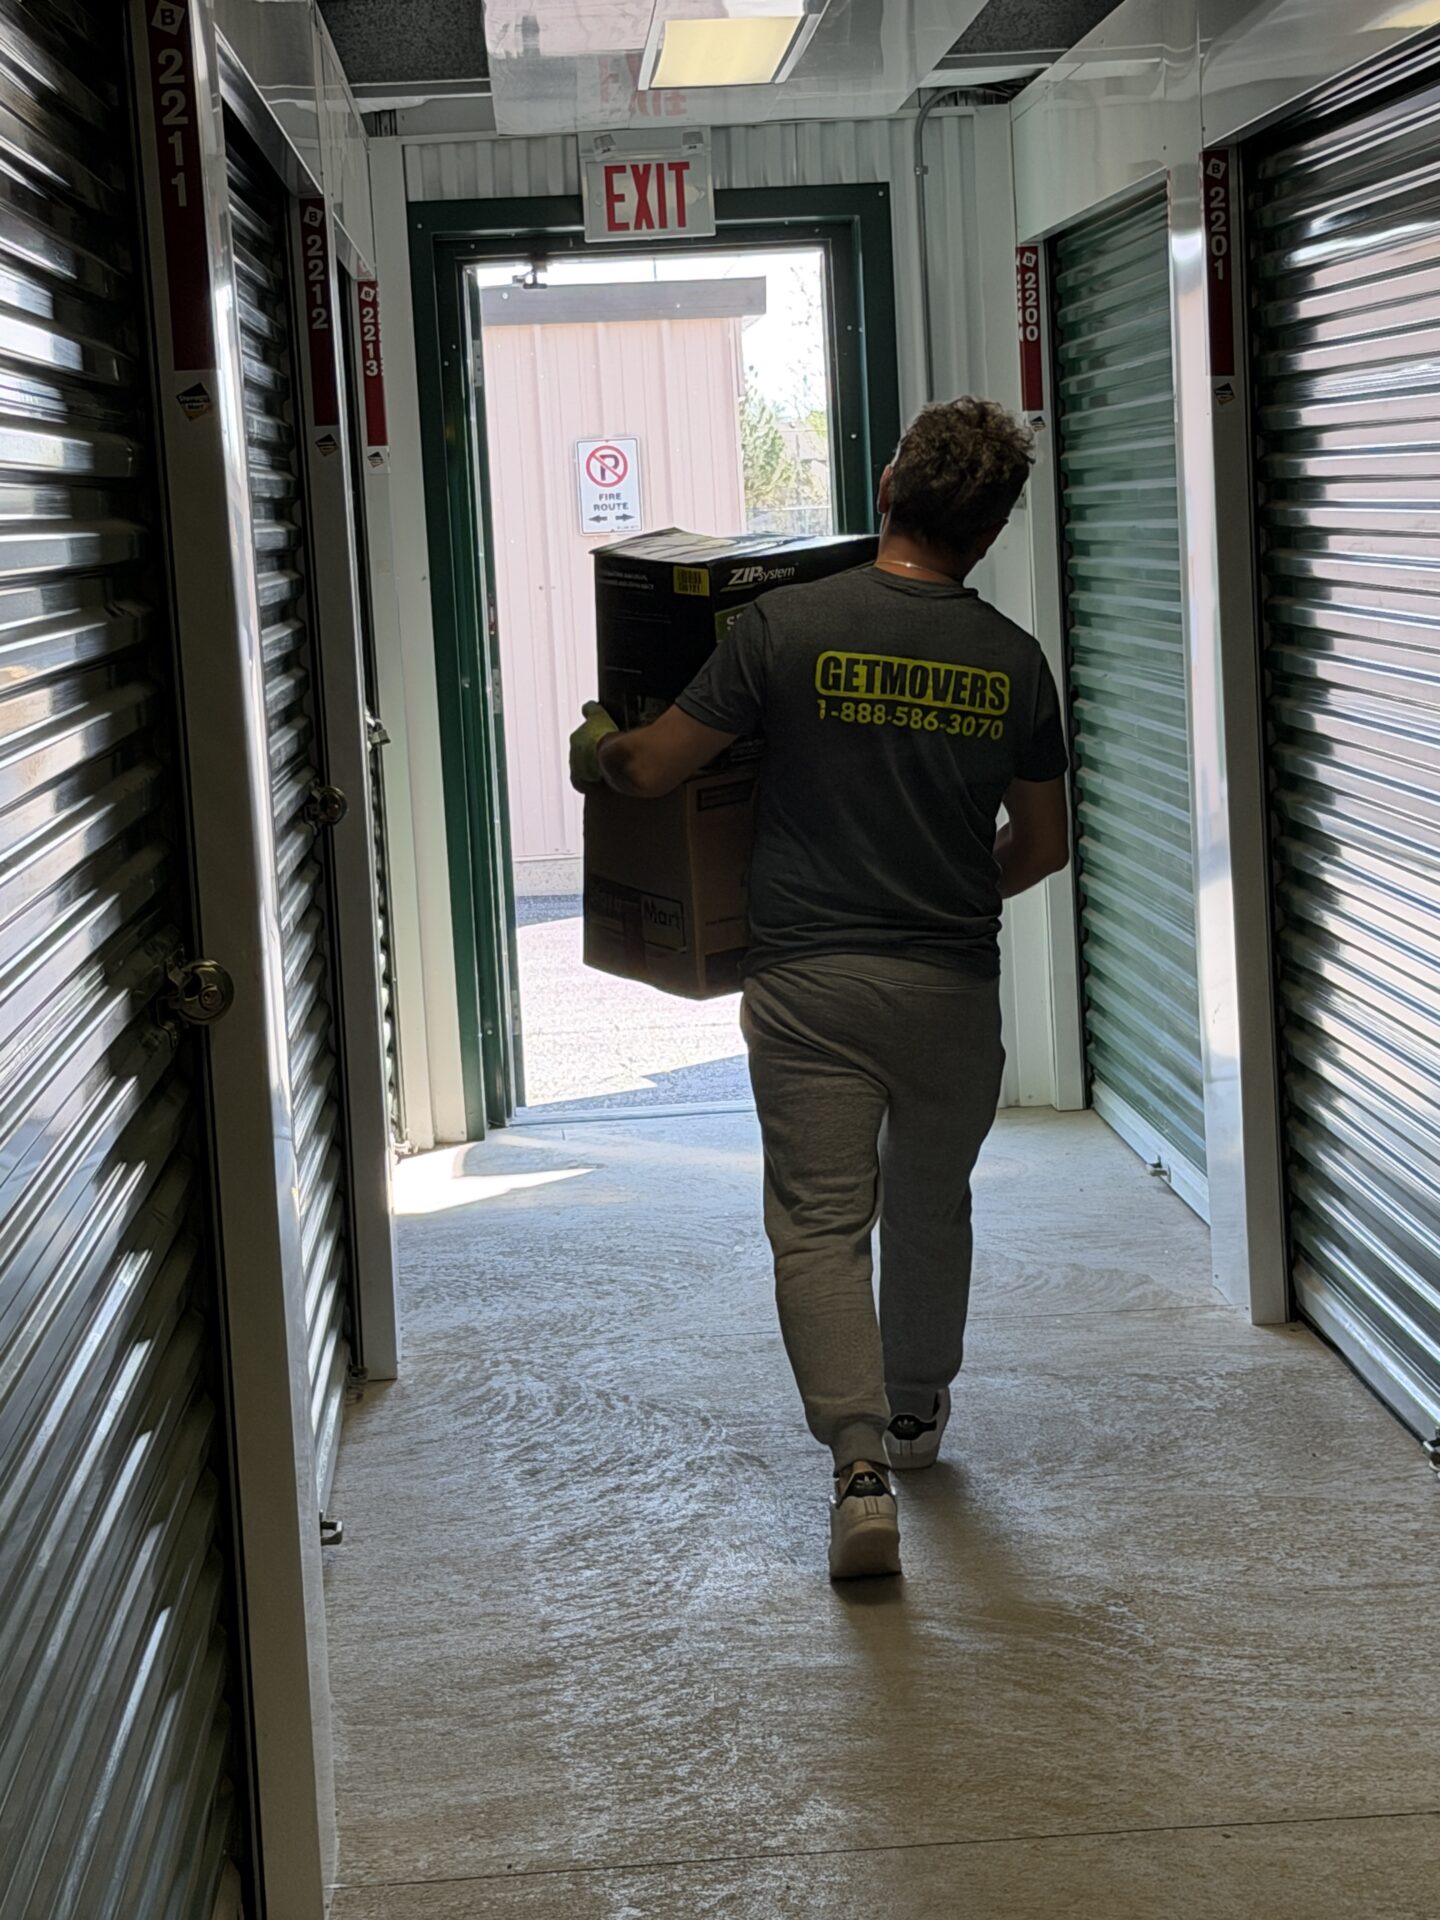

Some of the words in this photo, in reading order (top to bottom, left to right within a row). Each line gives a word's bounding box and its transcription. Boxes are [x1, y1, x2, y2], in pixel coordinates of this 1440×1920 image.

[160, 8, 177, 26] B
[158, 48, 189, 207] 2211
[604, 162, 690, 232] EXIT
[1211, 163, 1221, 174] B
[1209, 186, 1228, 280] 2201
[306, 235, 329, 330] 2212
[1024, 271, 1039, 342] 2200
[362, 307, 379, 377] 2213
[593, 502, 630, 512] ROUTE
[598, 492, 623, 502] FIRE
